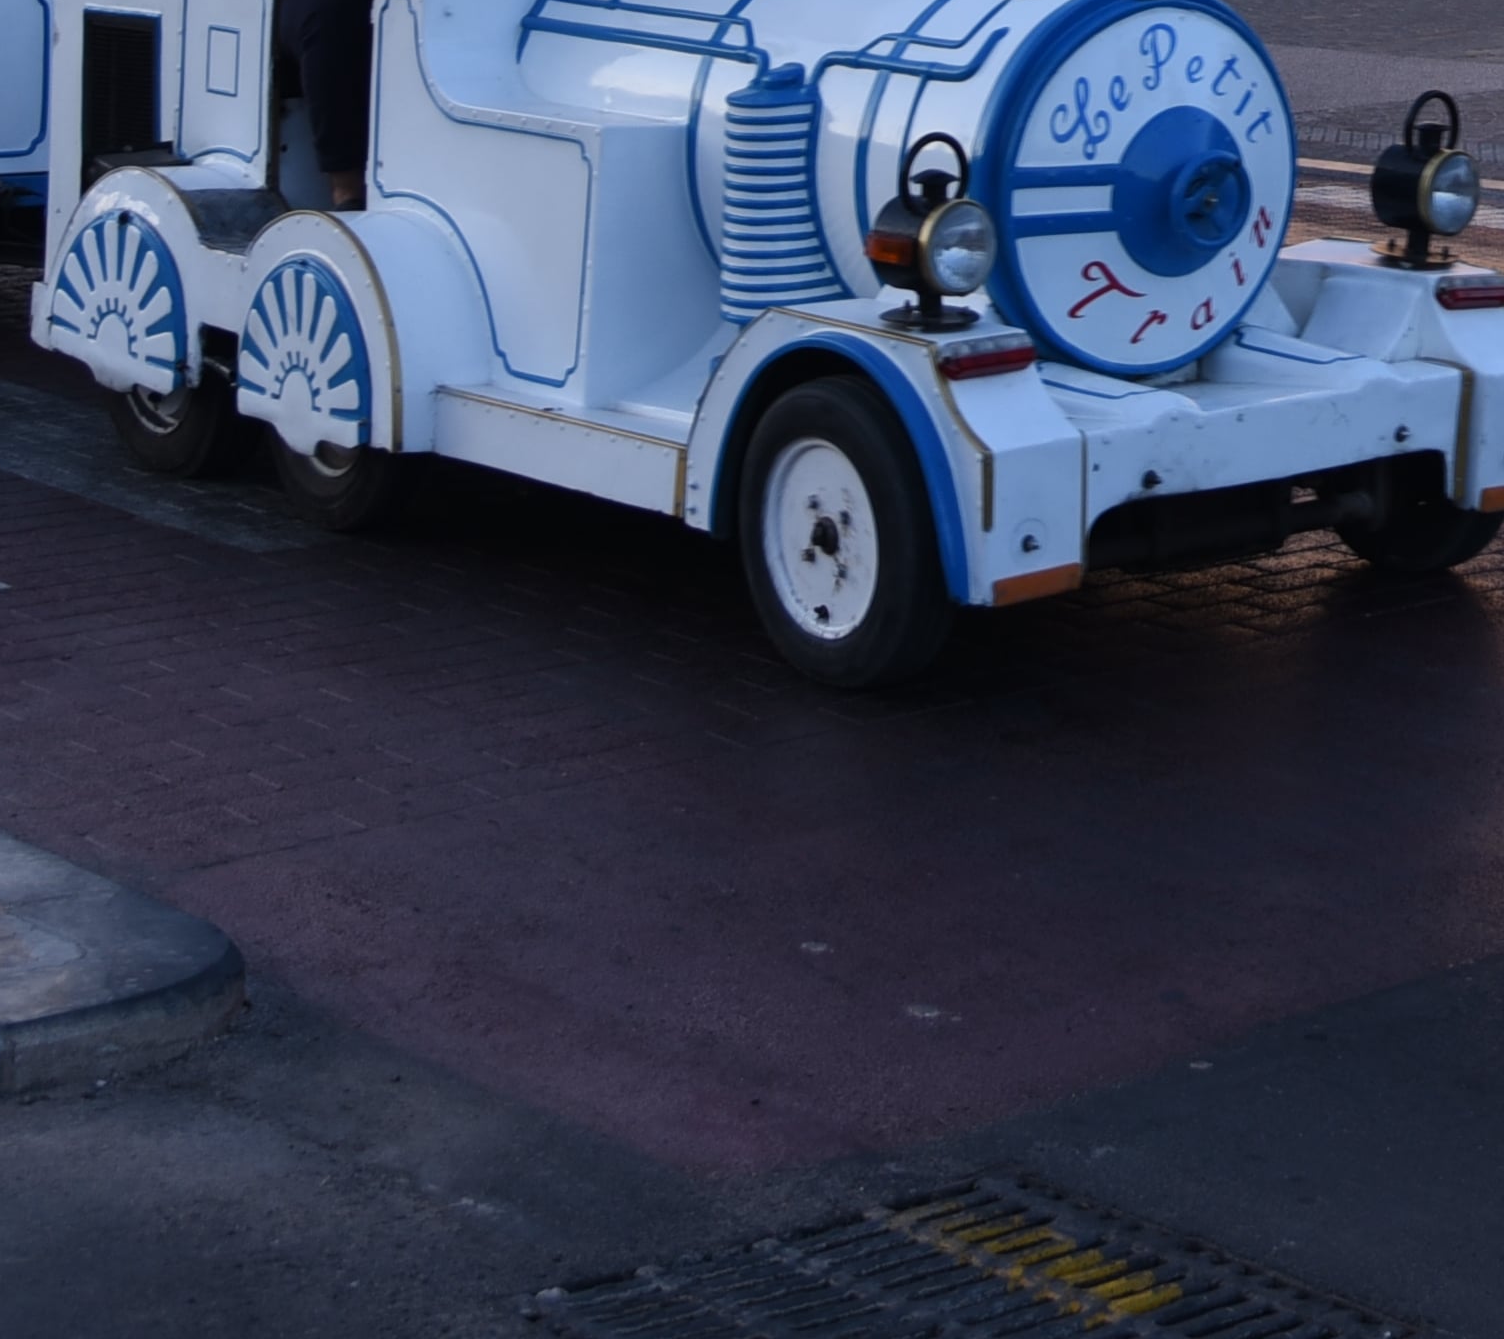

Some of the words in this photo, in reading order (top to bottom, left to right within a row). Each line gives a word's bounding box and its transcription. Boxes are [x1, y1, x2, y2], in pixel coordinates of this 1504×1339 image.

[1050, 75, 1132, 161] Le
[1139, 22, 1276, 145] Petit
[1068, 204, 1275, 345] Train
